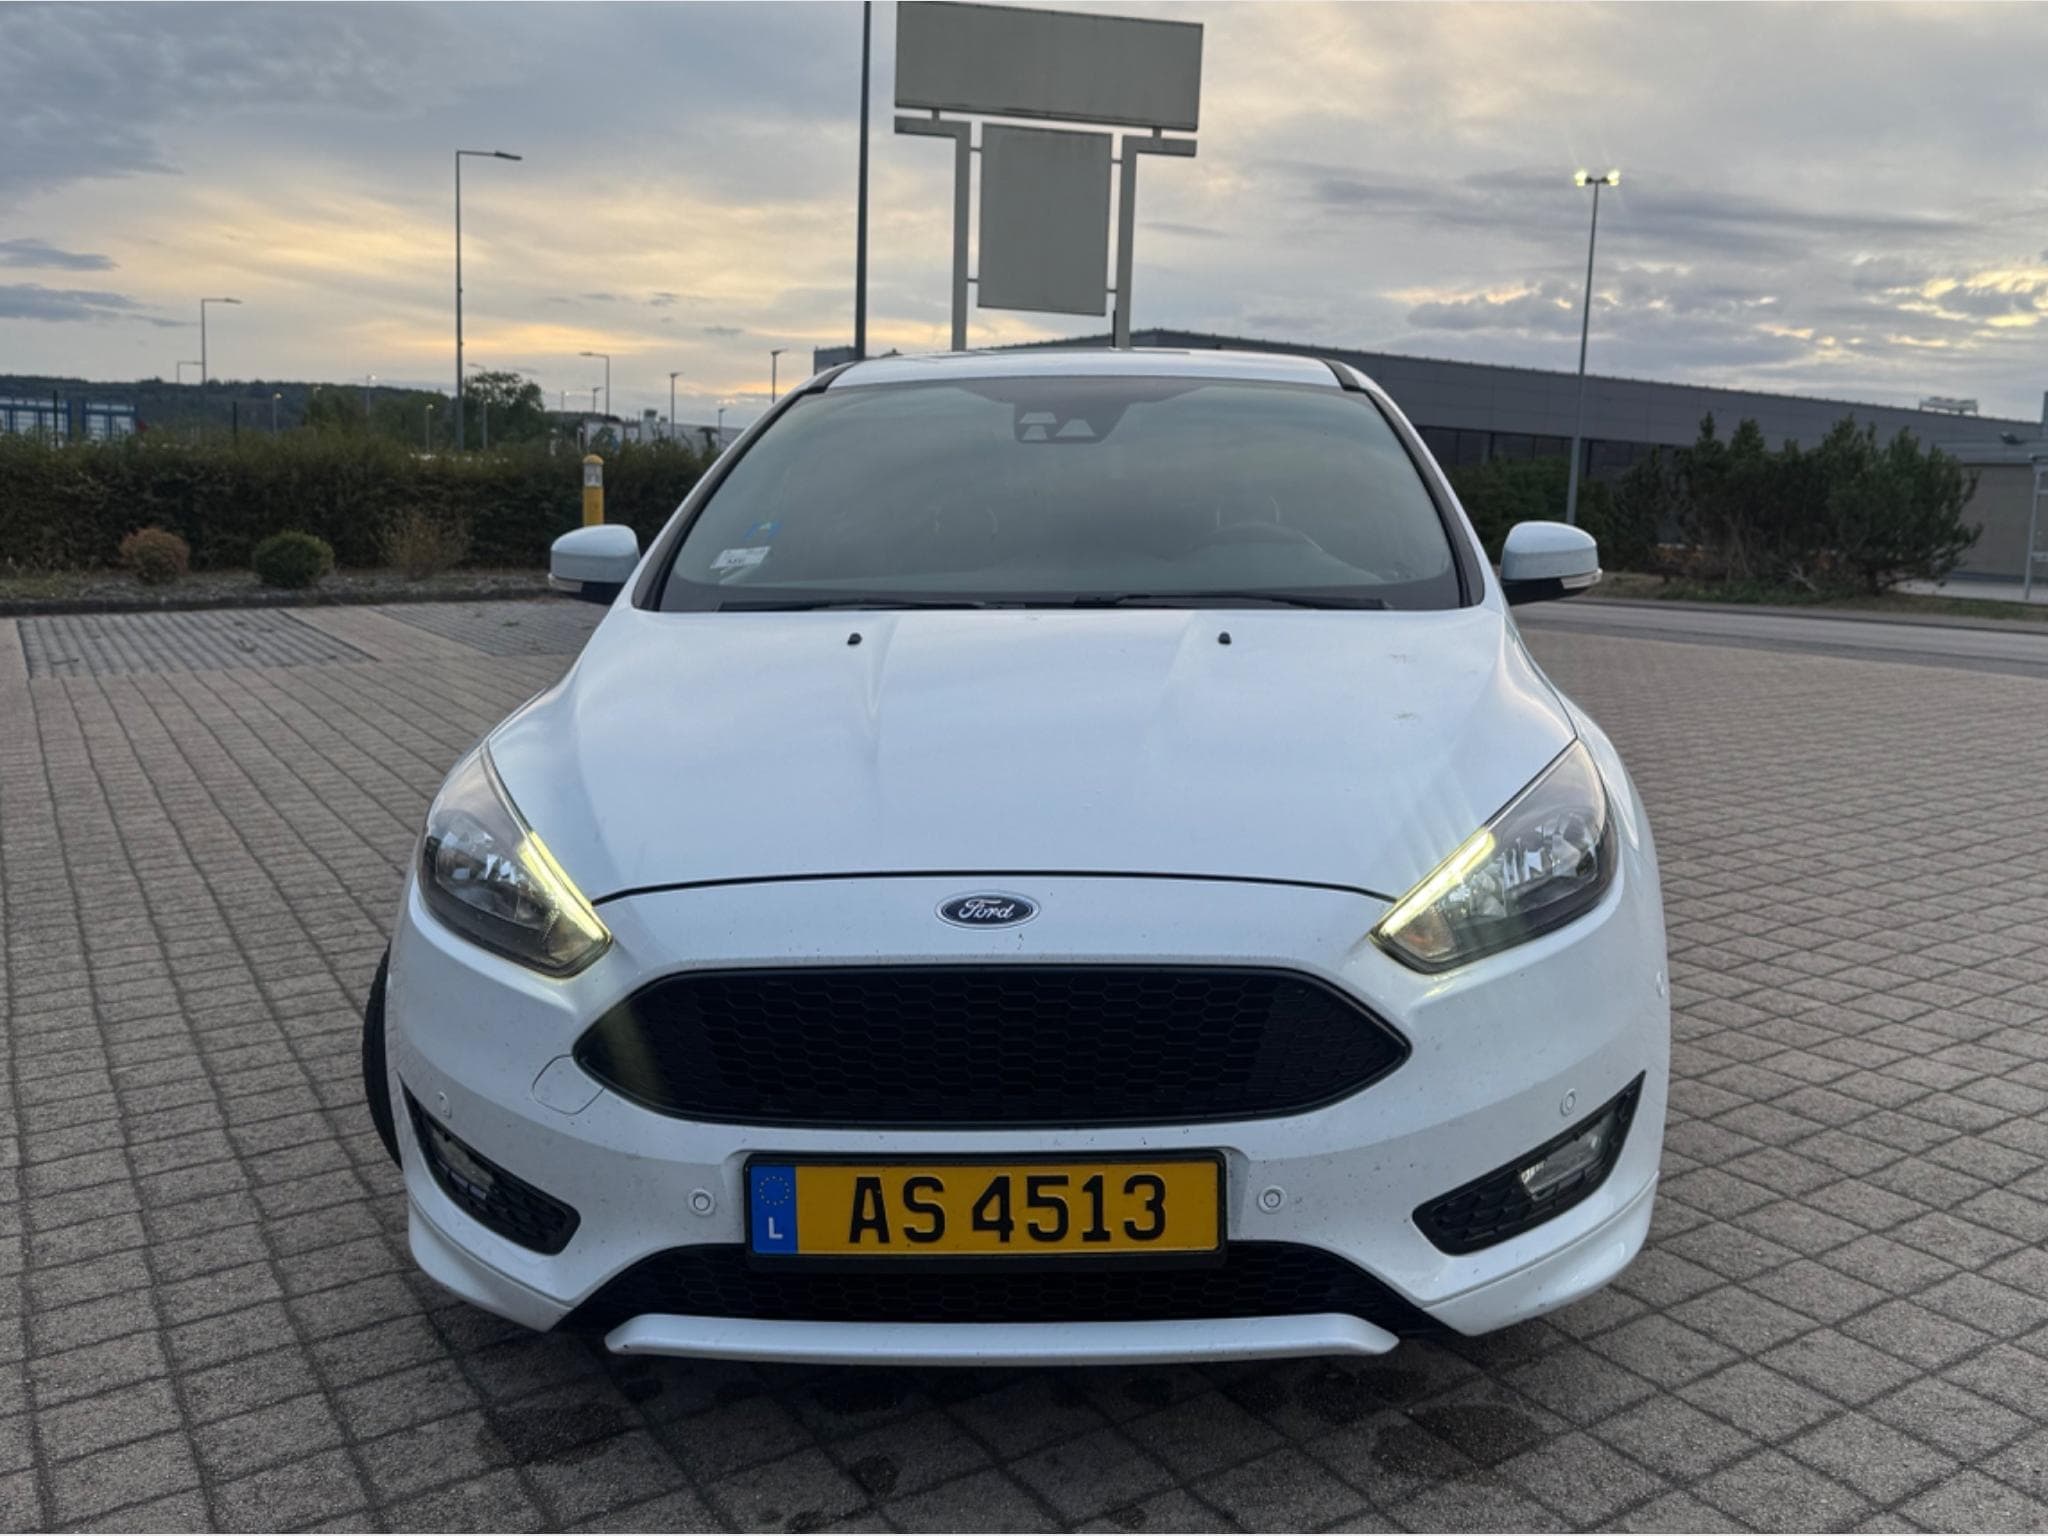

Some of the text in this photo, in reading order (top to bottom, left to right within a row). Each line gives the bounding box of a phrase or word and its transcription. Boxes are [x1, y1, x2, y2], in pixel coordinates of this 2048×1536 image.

[958, 898, 1016, 919] Ford
[849, 1174, 1166, 1244] AS 4513
[768, 1217, 783, 1240] L
